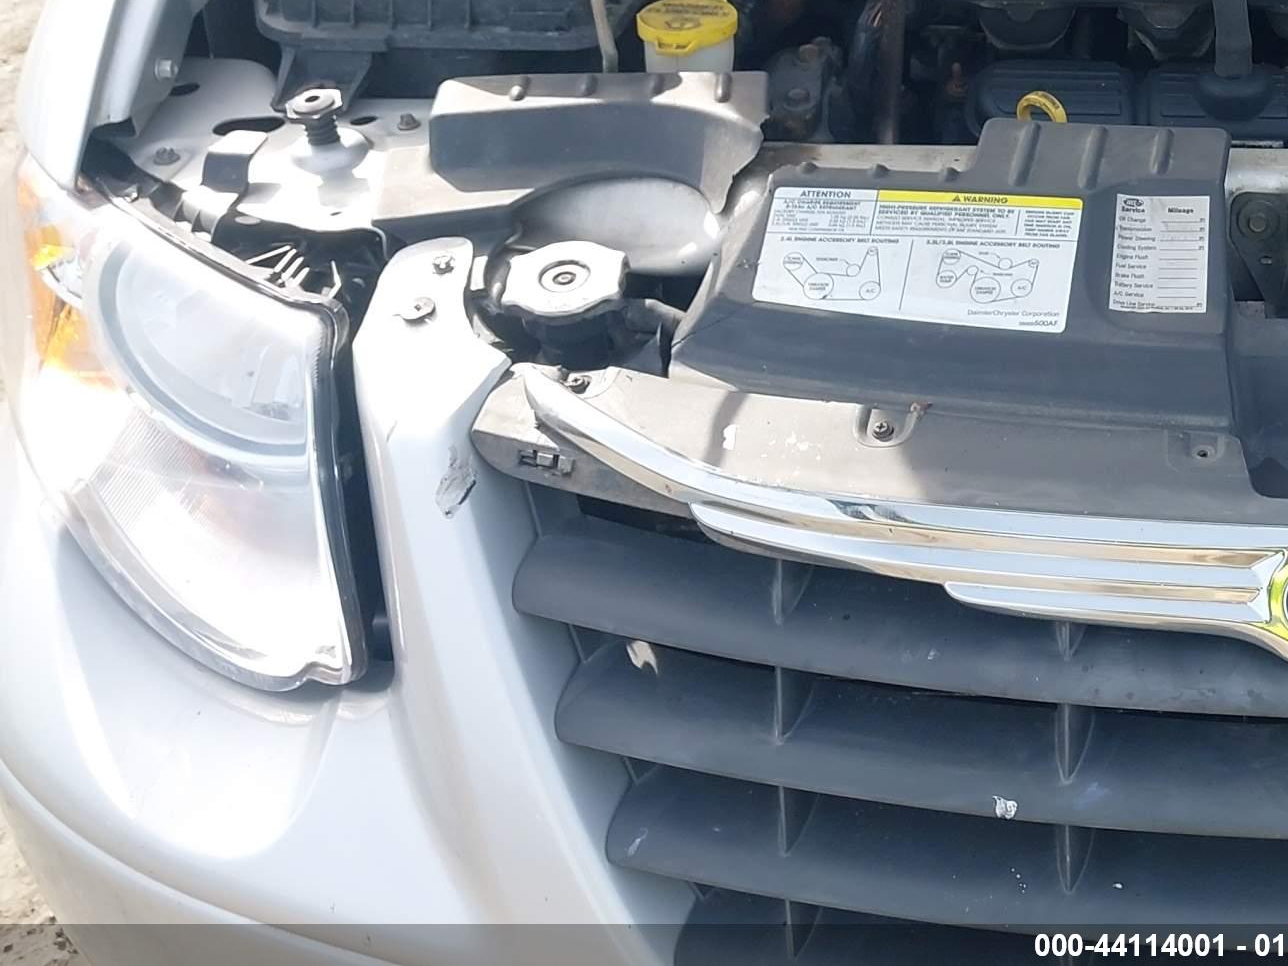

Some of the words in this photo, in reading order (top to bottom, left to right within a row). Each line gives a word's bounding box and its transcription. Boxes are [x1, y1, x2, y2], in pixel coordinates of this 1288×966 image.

[800, 190, 851, 199] ATTENTION
[963, 196, 1009, 205] WARNING
[1167, 207, 1194, 215] Mileage
[1119, 224, 1152, 232] Transmission
[1117, 243, 1136, 251] Cooling
[1114, 280, 1132, 288] Battery
[967, 309, 1020, 317] DaimlerChrysler
[1021, 310, 1060, 318] Corporation
